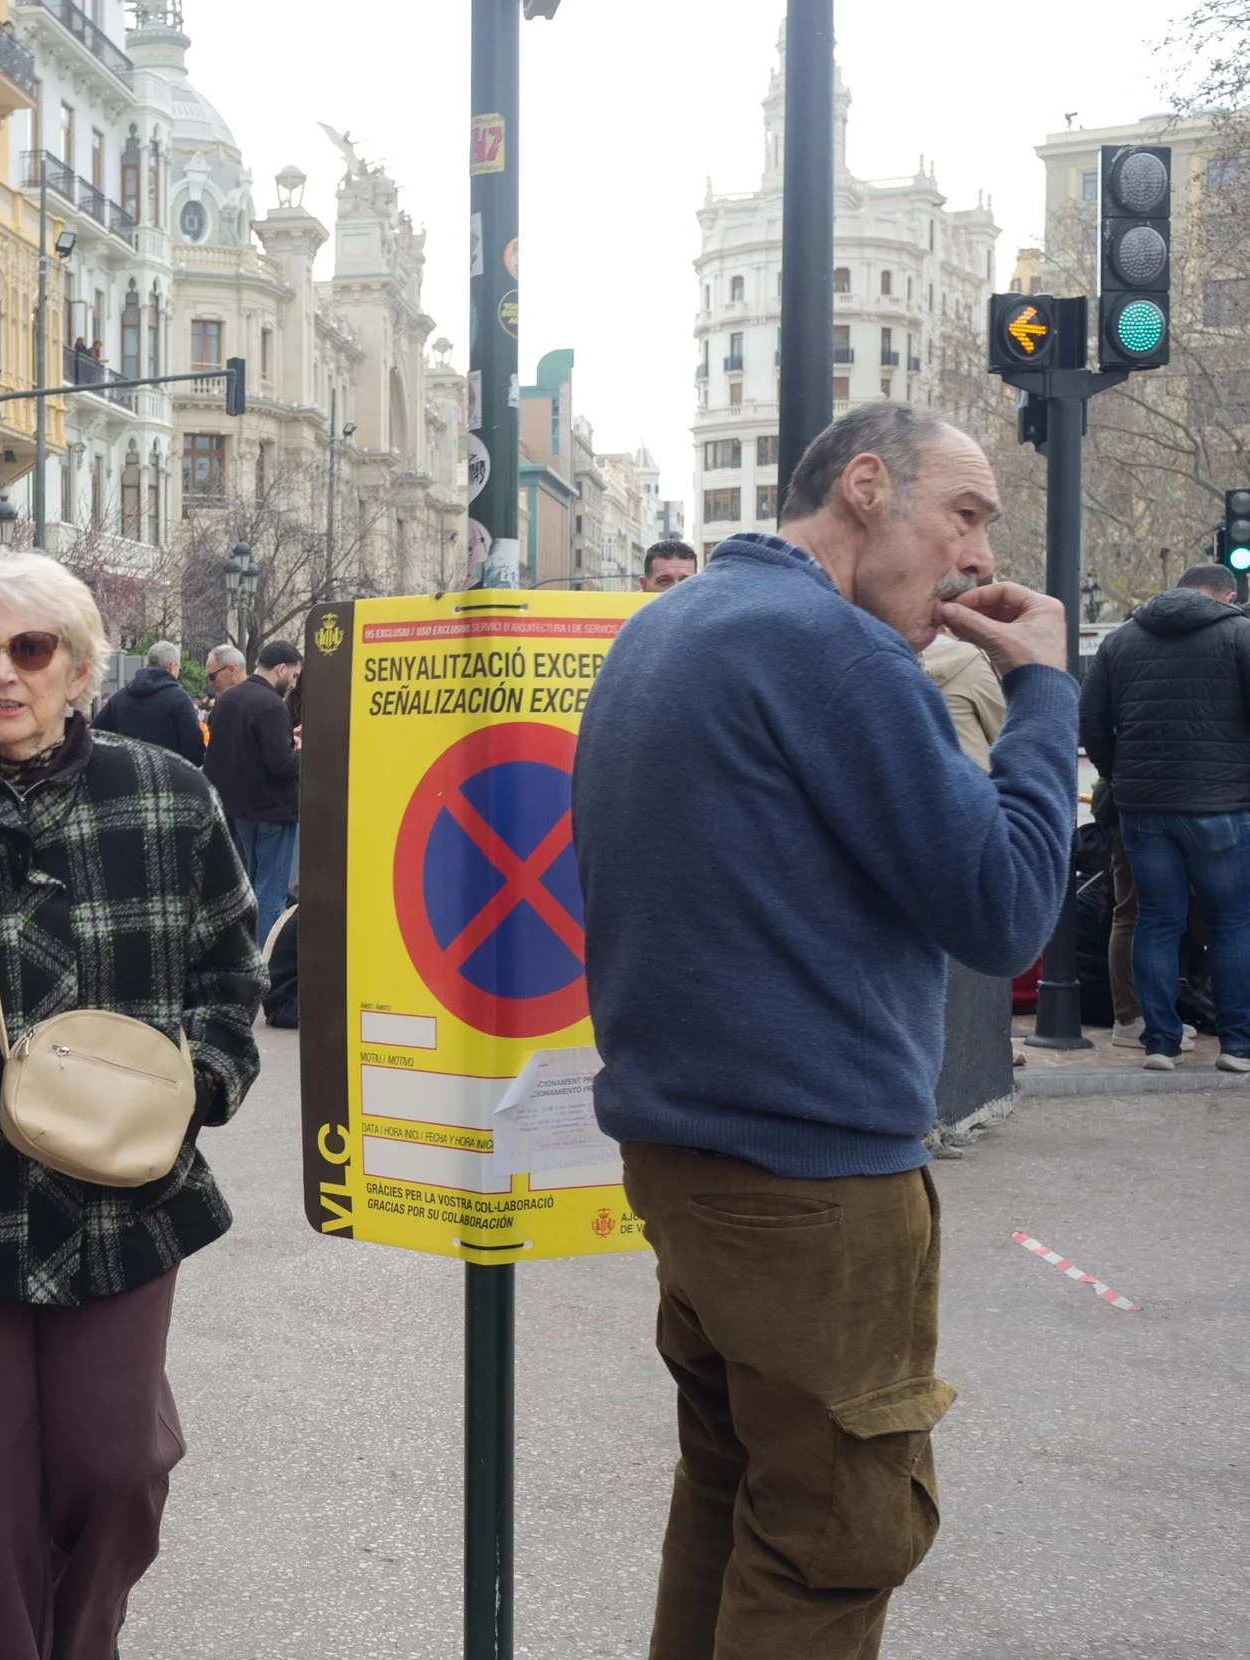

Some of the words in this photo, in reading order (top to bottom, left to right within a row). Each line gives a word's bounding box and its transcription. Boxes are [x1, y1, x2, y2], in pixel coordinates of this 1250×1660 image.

[364, 646, 525, 682] SENYALITZACIÓ
[534, 652, 605, 679] EXCEP
[369, 681, 524, 716] SEÑALIZACIÓN
[530, 687, 591, 713] EXCE
[388, 1055, 414, 1067] MOTIVO
[583, 1075, 594, 1084] PR
[362, 1123, 379, 1133] DATA
[384, 1126, 402, 1137] HORA
[425, 1131, 447, 1144] FECHA
[456, 1136, 475, 1147] HORA
[317, 1123, 354, 1234] VLC
[366, 1182, 403, 1199] GRÀCIES
[405, 1189, 422, 1201] PER
[424, 1192, 436, 1204] LA
[438, 1194, 472, 1211] VOSTRA
[368, 1198, 405, 1215] GRACIAS
[407, 1205, 425, 1218] POR
[427, 1209, 439, 1220] SU
[441, 1211, 514, 1229] COLABORACIÓN
[621, 1225, 633, 1233] DE
[636, 1223, 643, 1232] V
